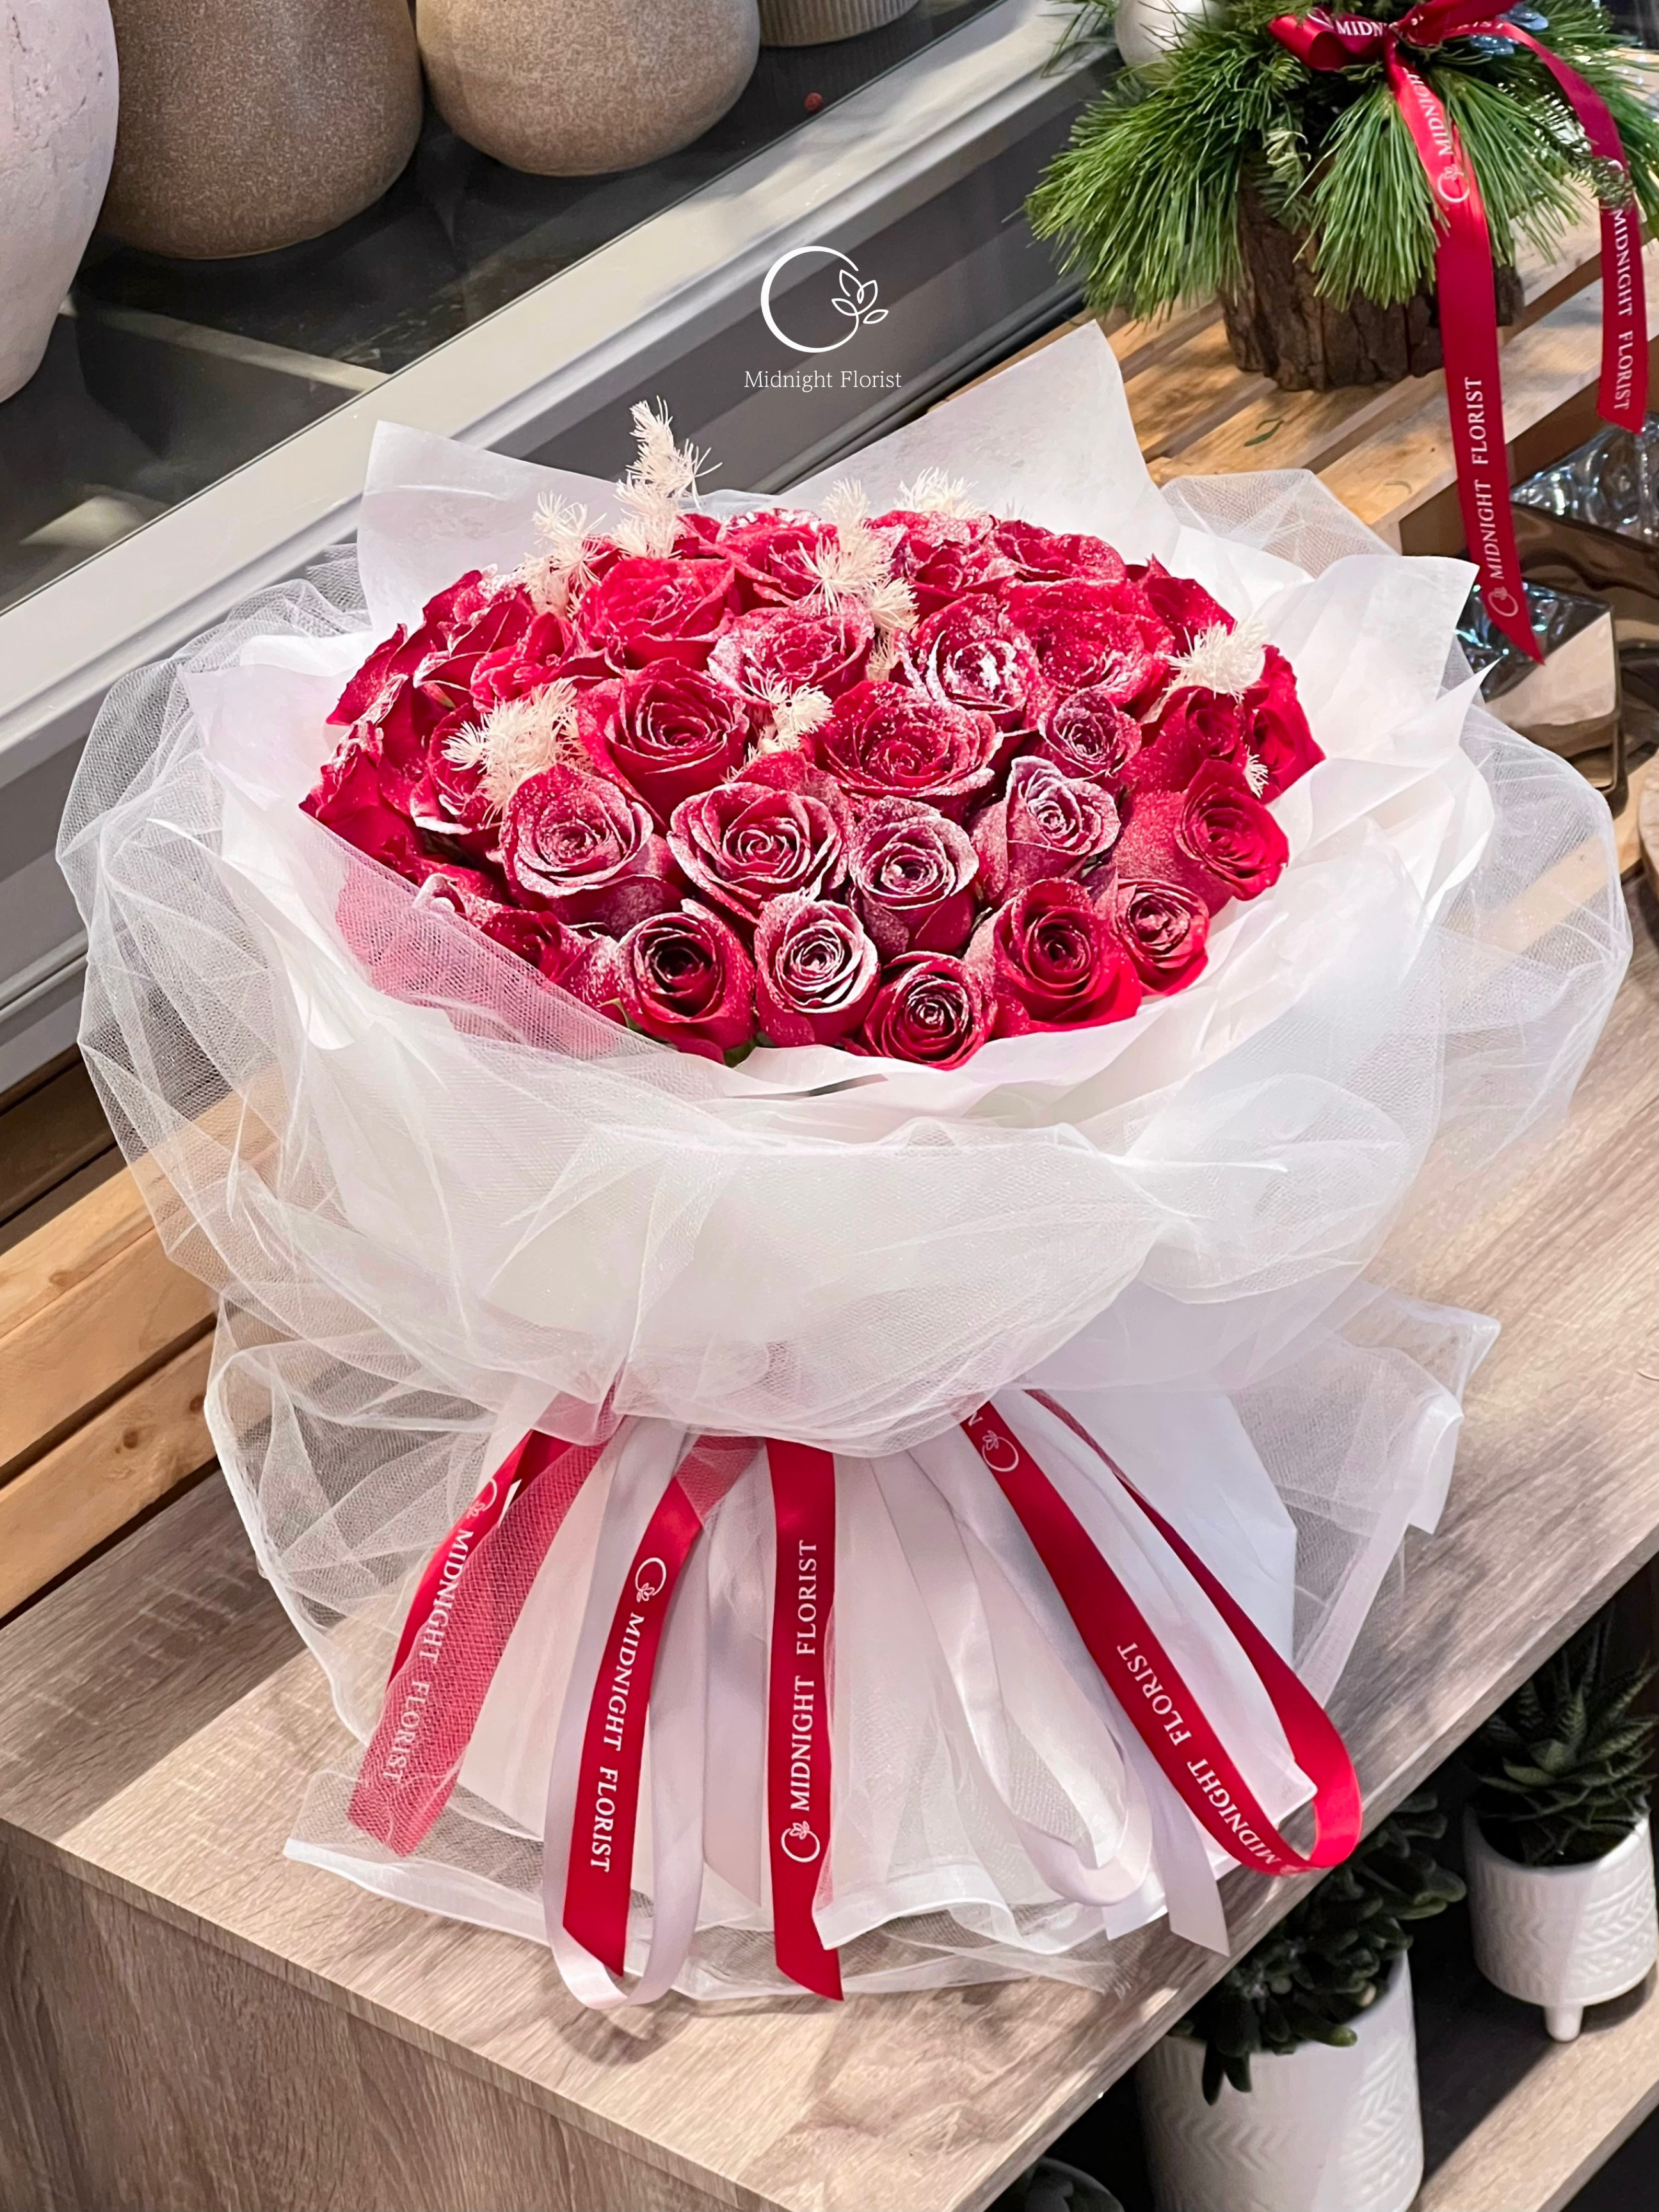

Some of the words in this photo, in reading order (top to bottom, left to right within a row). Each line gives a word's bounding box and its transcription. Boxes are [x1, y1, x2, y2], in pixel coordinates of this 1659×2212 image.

[1614, 208, 1633, 316] MIDNIGHT
[1464, 376, 1489, 465] FLORIST
[1614, 330, 1633, 410] FLORIST
[1474, 479, 1504, 580] MIDNIGHT
[419, 1528, 474, 1664] MIDNIGHT
[796, 1540, 817, 1655] FLORIST
[383, 1680, 430, 1784] FLORIST
[604, 1612, 645, 1752] MIDNIGHT
[1117, 1642, 1192, 1746] FLORIST
[790, 1675, 815, 1811] MIDNIGHT
[591, 1766, 618, 1873] FLORIST
[1187, 1758, 1282, 1864] MIDNIGHT
